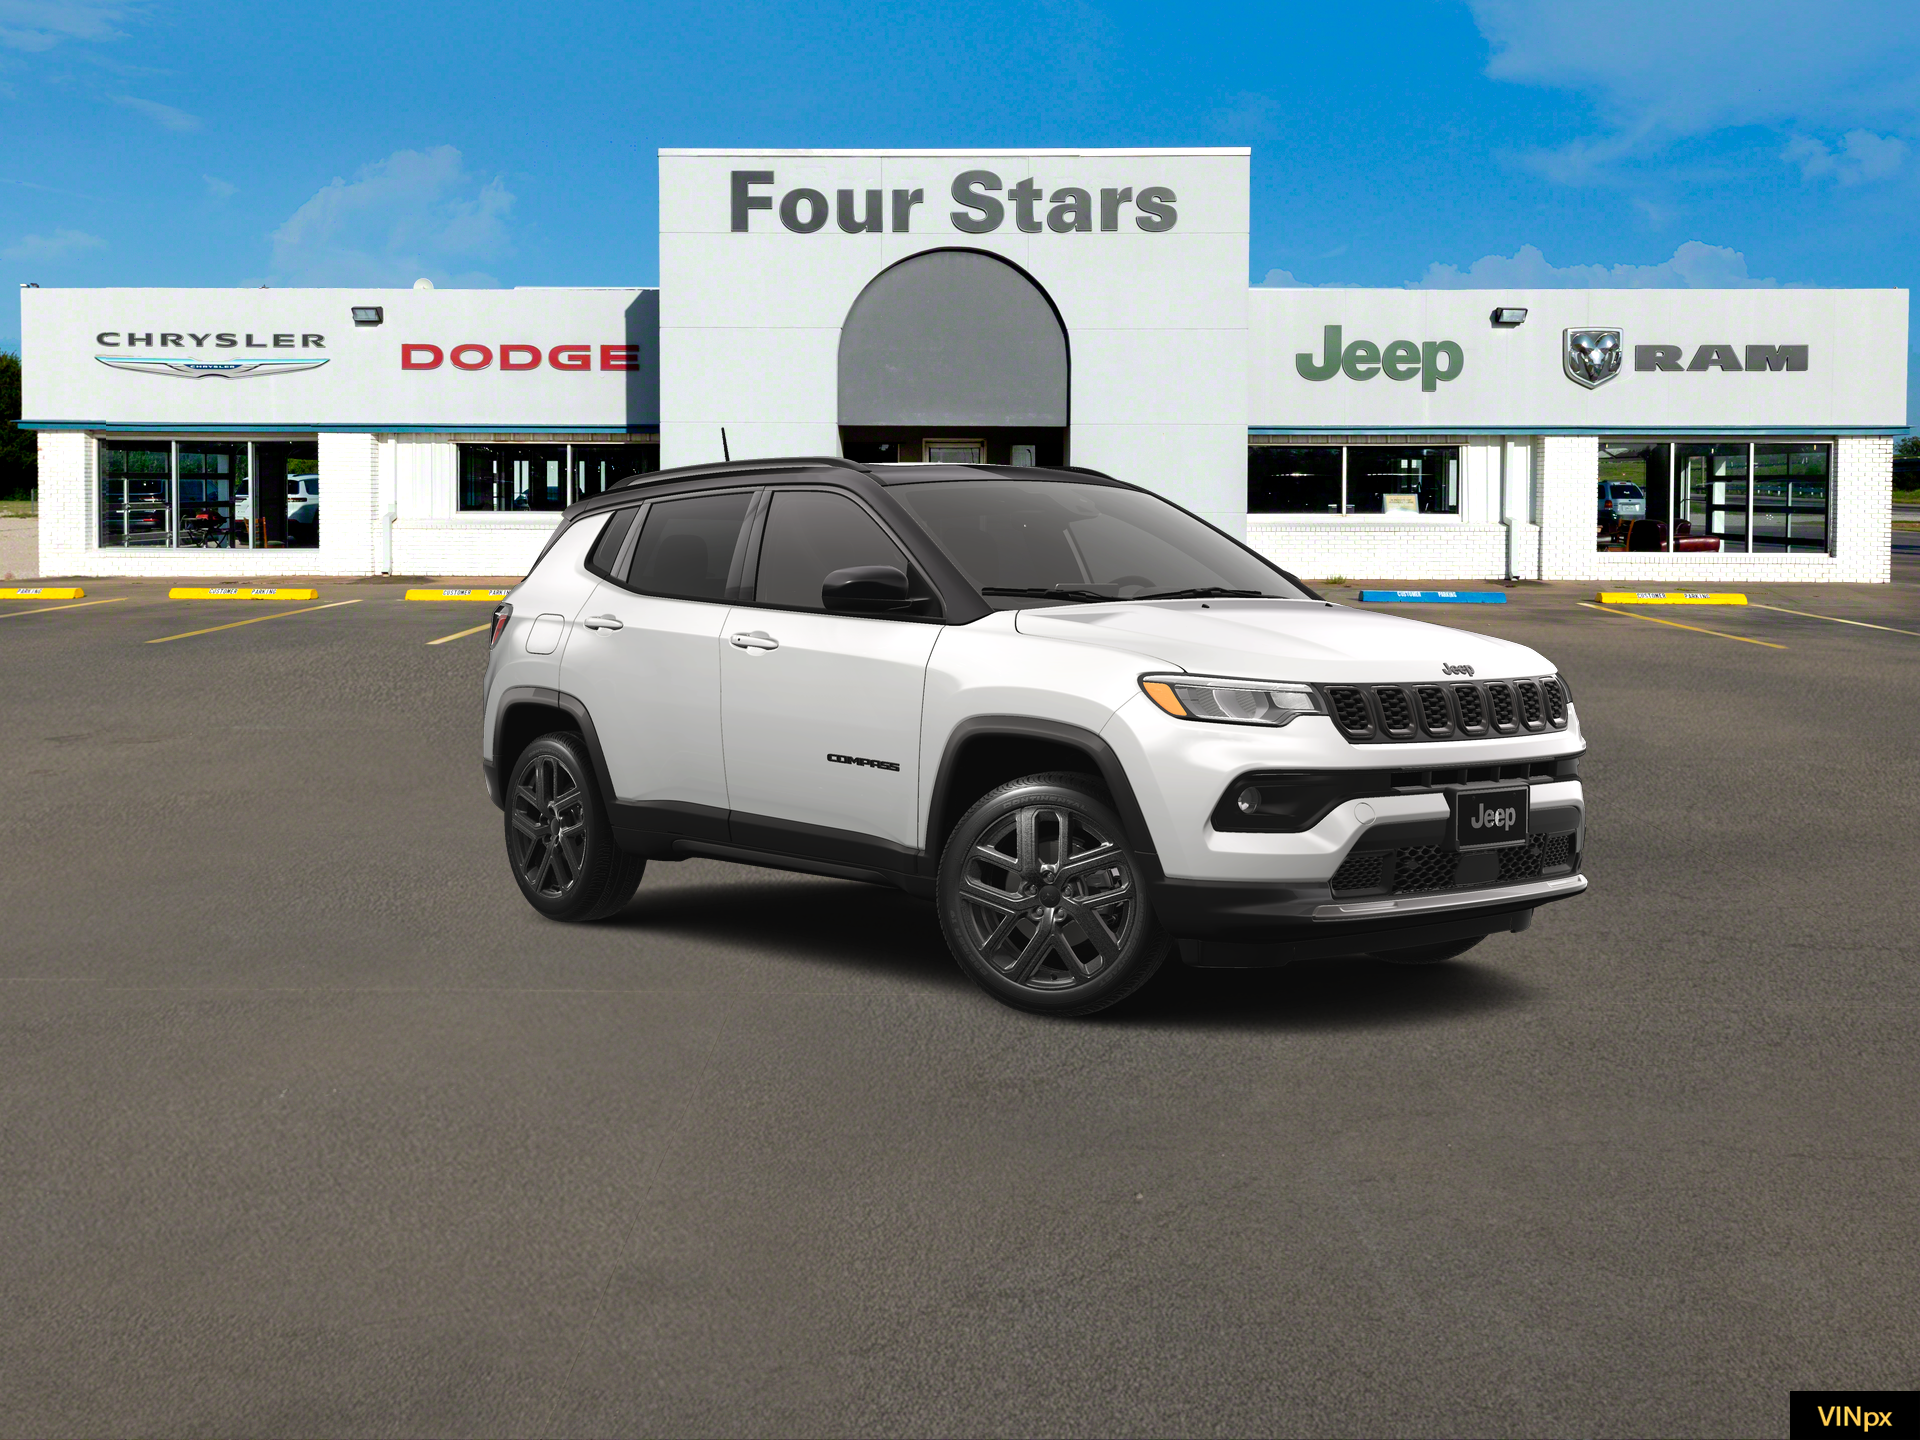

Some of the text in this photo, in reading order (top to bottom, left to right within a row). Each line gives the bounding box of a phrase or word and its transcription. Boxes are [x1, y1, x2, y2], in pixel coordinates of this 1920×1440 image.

[731, 170, 1178, 233] Four Stars
[96, 332, 326, 348] CHRYSLER
[401, 343, 640, 371] DODGE
[1296, 325, 1464, 392] Jeep
[1635, 344, 1809, 371] RAM
[1442, 662, 1475, 677] Jeep
[827, 753, 900, 772] COMPASS
[1471, 803, 1516, 831] Jeep
